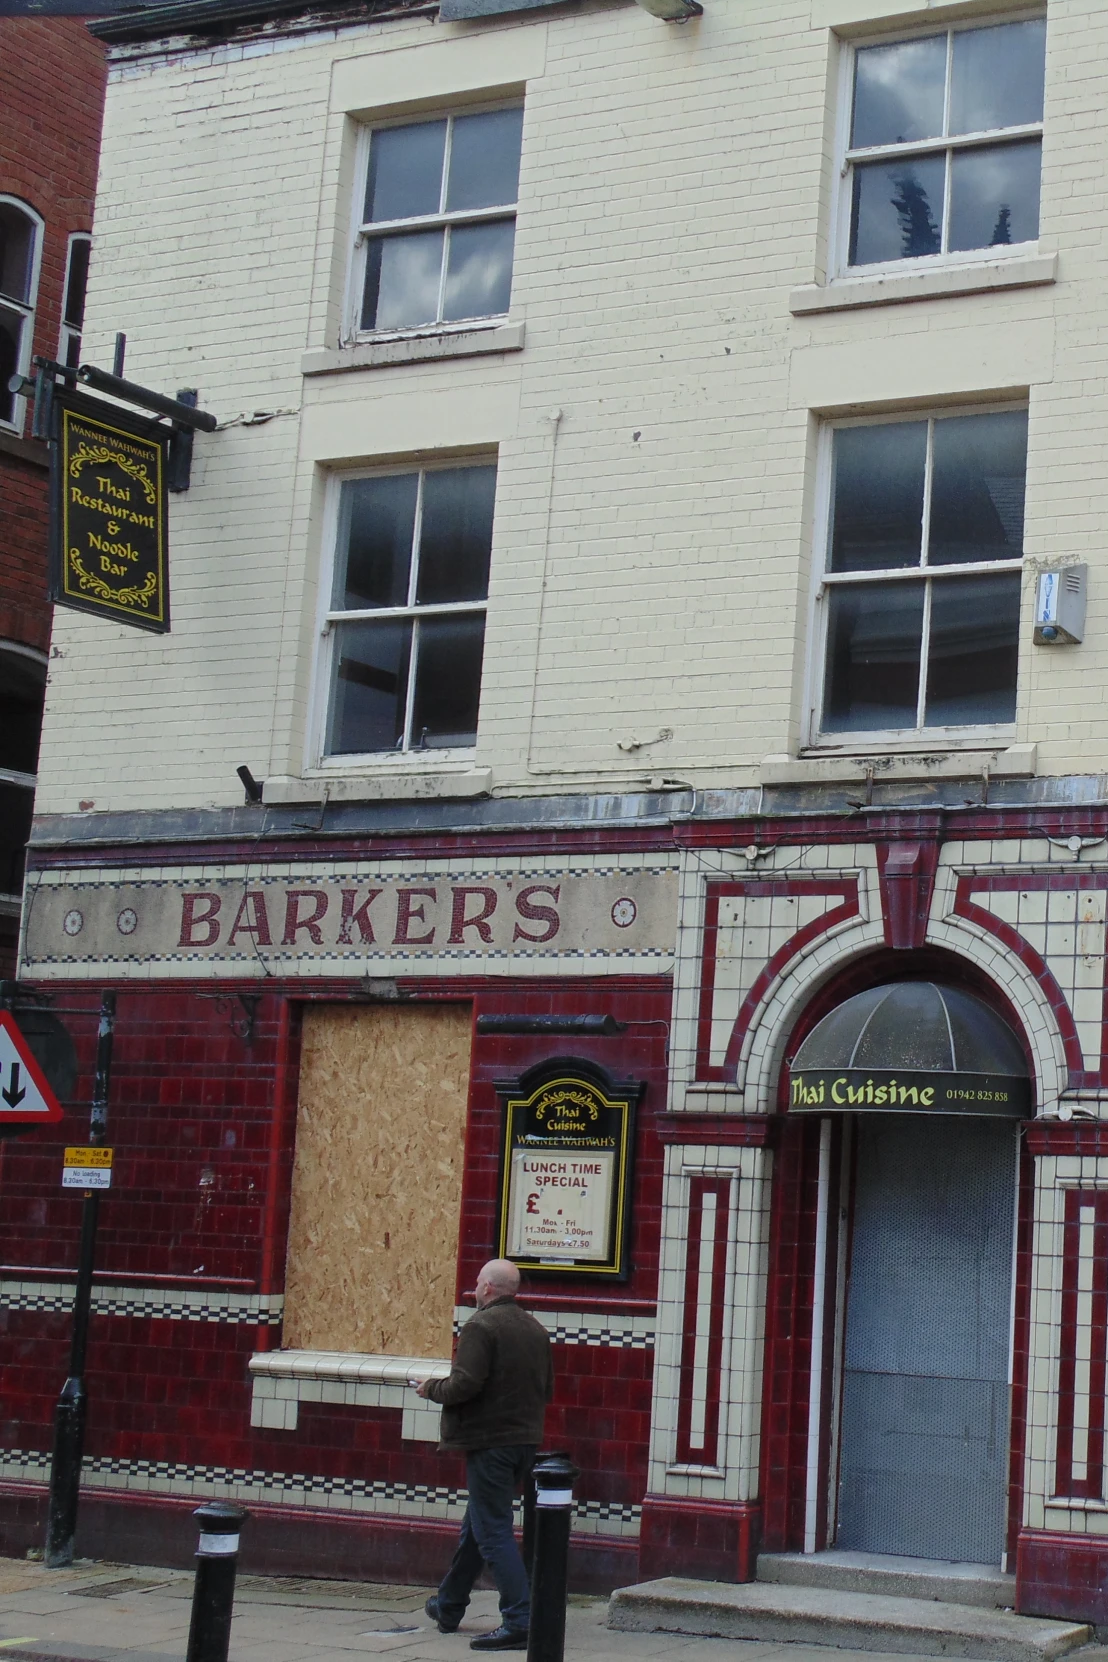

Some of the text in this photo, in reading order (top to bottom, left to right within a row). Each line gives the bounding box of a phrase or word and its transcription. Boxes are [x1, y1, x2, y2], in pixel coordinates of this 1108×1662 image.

[70, 422, 155, 462] WANNEE WAHWAH'S
[96, 476, 130, 502] Thai
[70, 487, 155, 529] Restaurant
[107, 520, 121, 536] &
[87, 532, 139, 562] Noodle
[100, 555, 128, 578] Bar
[177, 882, 561, 948] BARKER'S
[792, 1076, 1009, 1106] Thai Cuisine 01942 825 858
[555, 1105, 580, 1118] Thai
[546, 1119, 586, 1131] Cuisine
[523, 1162, 602, 1175] LUNCH TIME
[535, 1176, 588, 1188] SPECIAL
[526, 1238, 566, 1248] Saturdays
